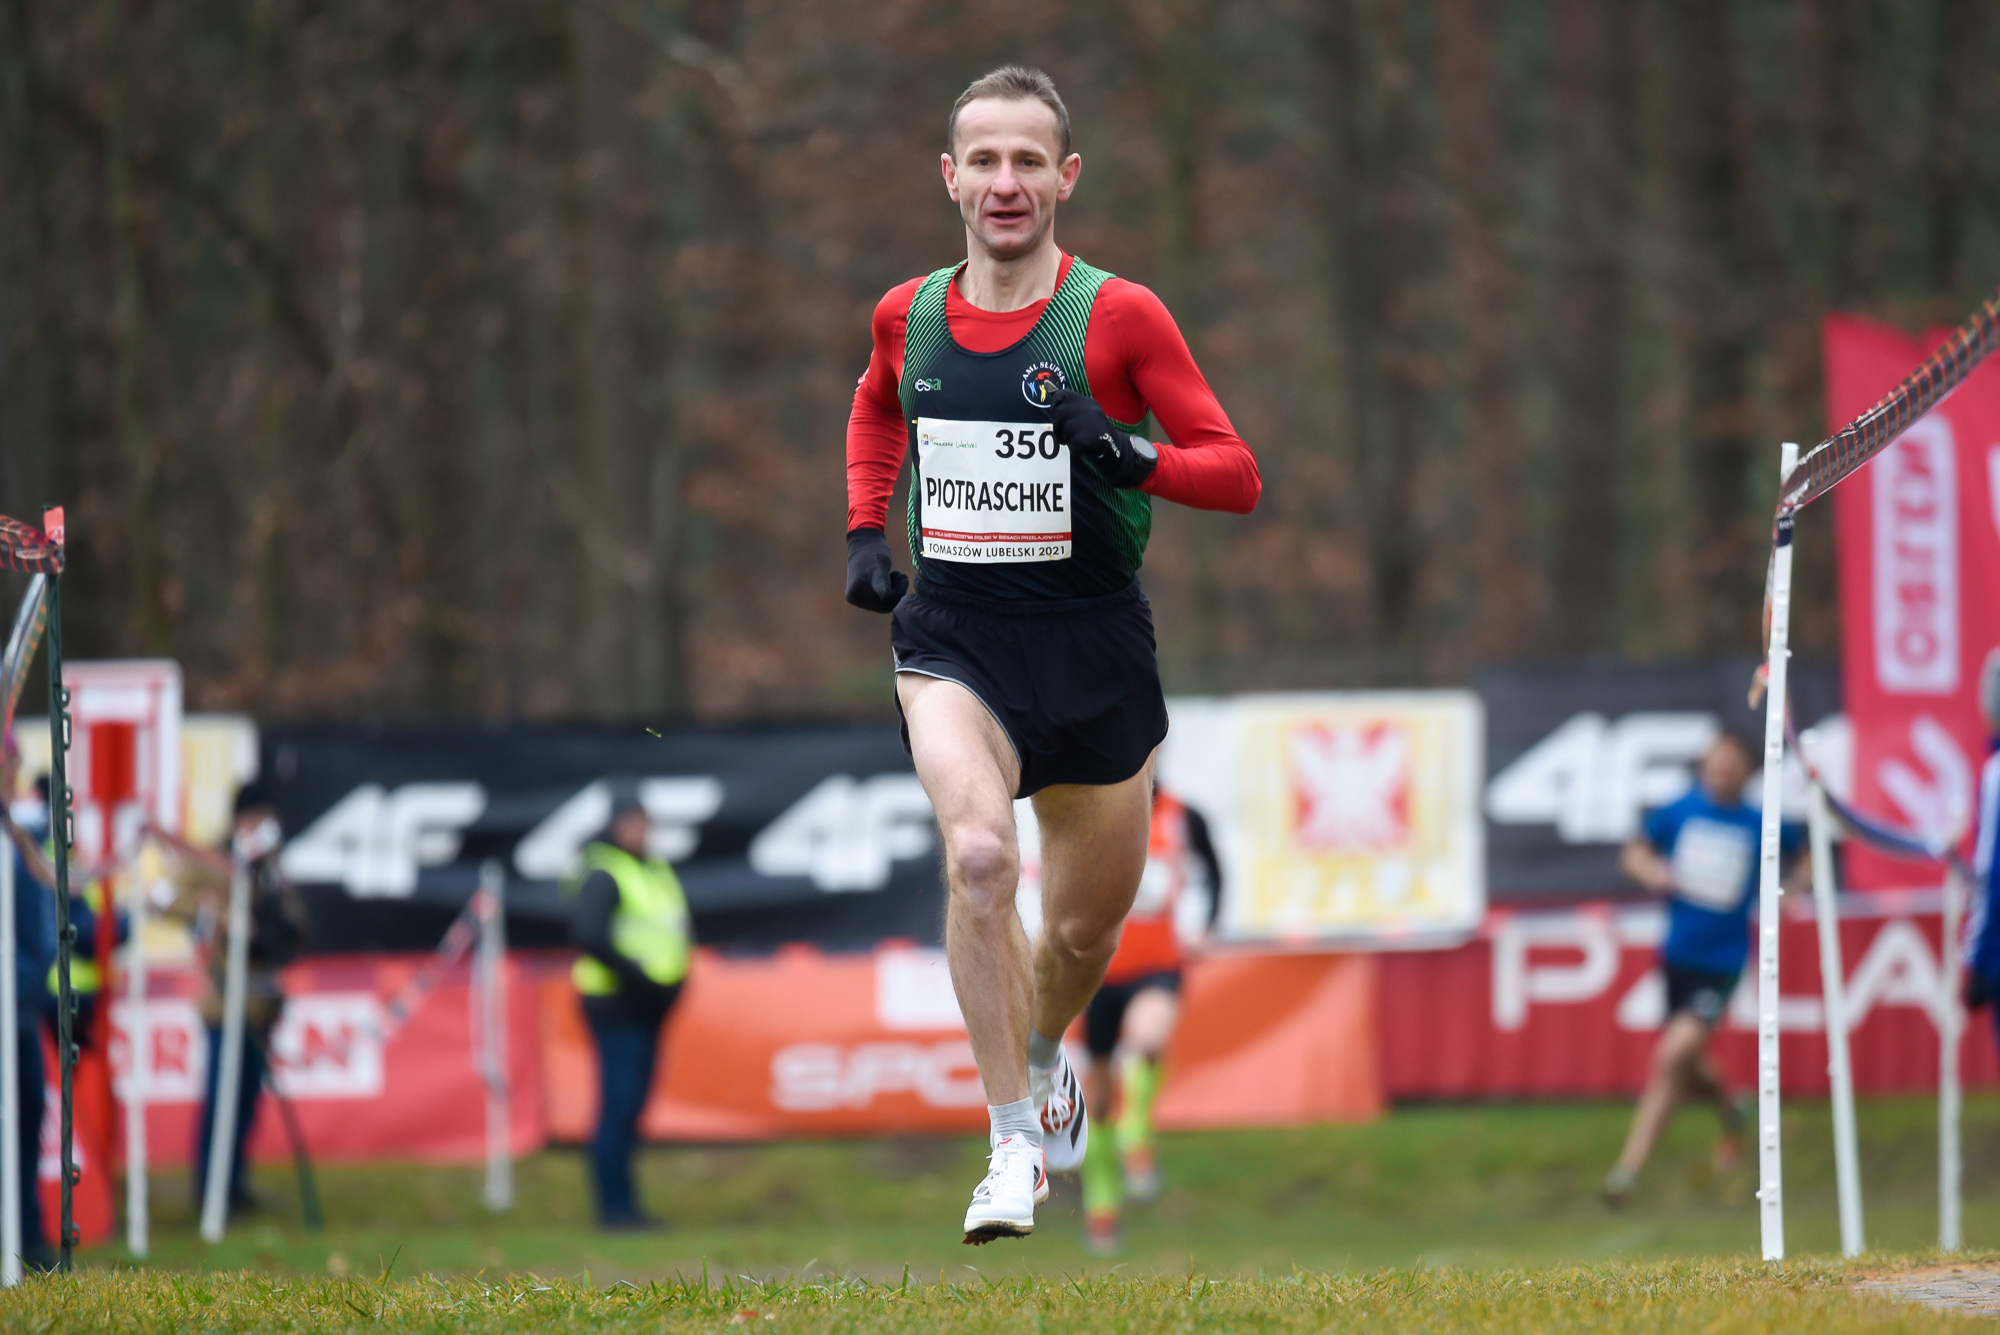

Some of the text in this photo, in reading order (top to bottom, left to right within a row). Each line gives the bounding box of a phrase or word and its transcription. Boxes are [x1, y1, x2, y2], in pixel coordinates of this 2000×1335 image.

[995, 429, 1061, 460] 350
[926, 476, 1064, 512] PIOTRASCHKE
[929, 543, 1065, 558] TOMASZÓW LUBELSKI 2021
